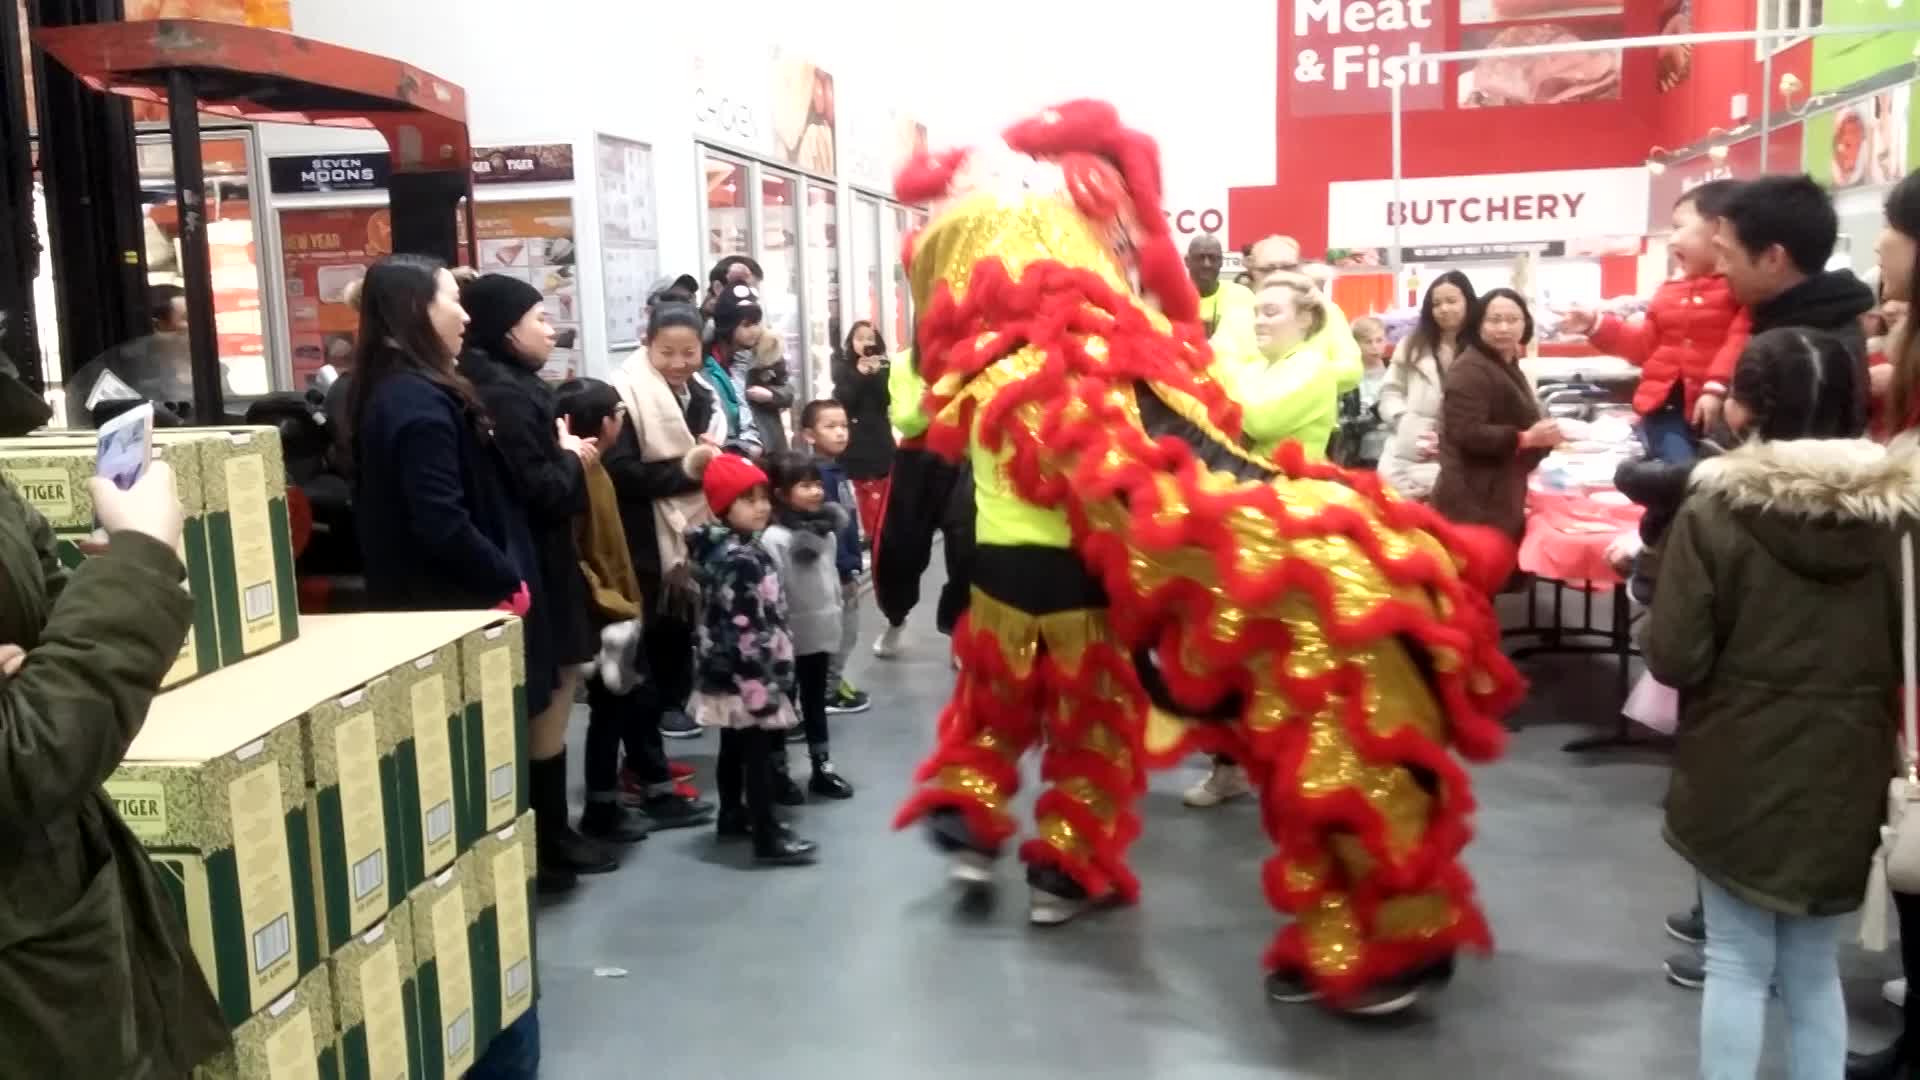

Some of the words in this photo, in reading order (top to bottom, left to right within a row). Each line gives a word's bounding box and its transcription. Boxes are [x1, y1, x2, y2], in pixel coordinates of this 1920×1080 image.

[1294, 0, 1433, 36] Meat
[1294, 49, 1327, 82] &
[1333, 42, 1440, 91] Fish
[311, 159, 362, 169] SEVEN
[472, 161, 492, 172] GER
[301, 168, 375, 182] MOONS
[1386, 192, 1586, 226] BUTCHERY
[309, 233, 340, 249] YEAR
[23, 484, 65, 500] TIGER
